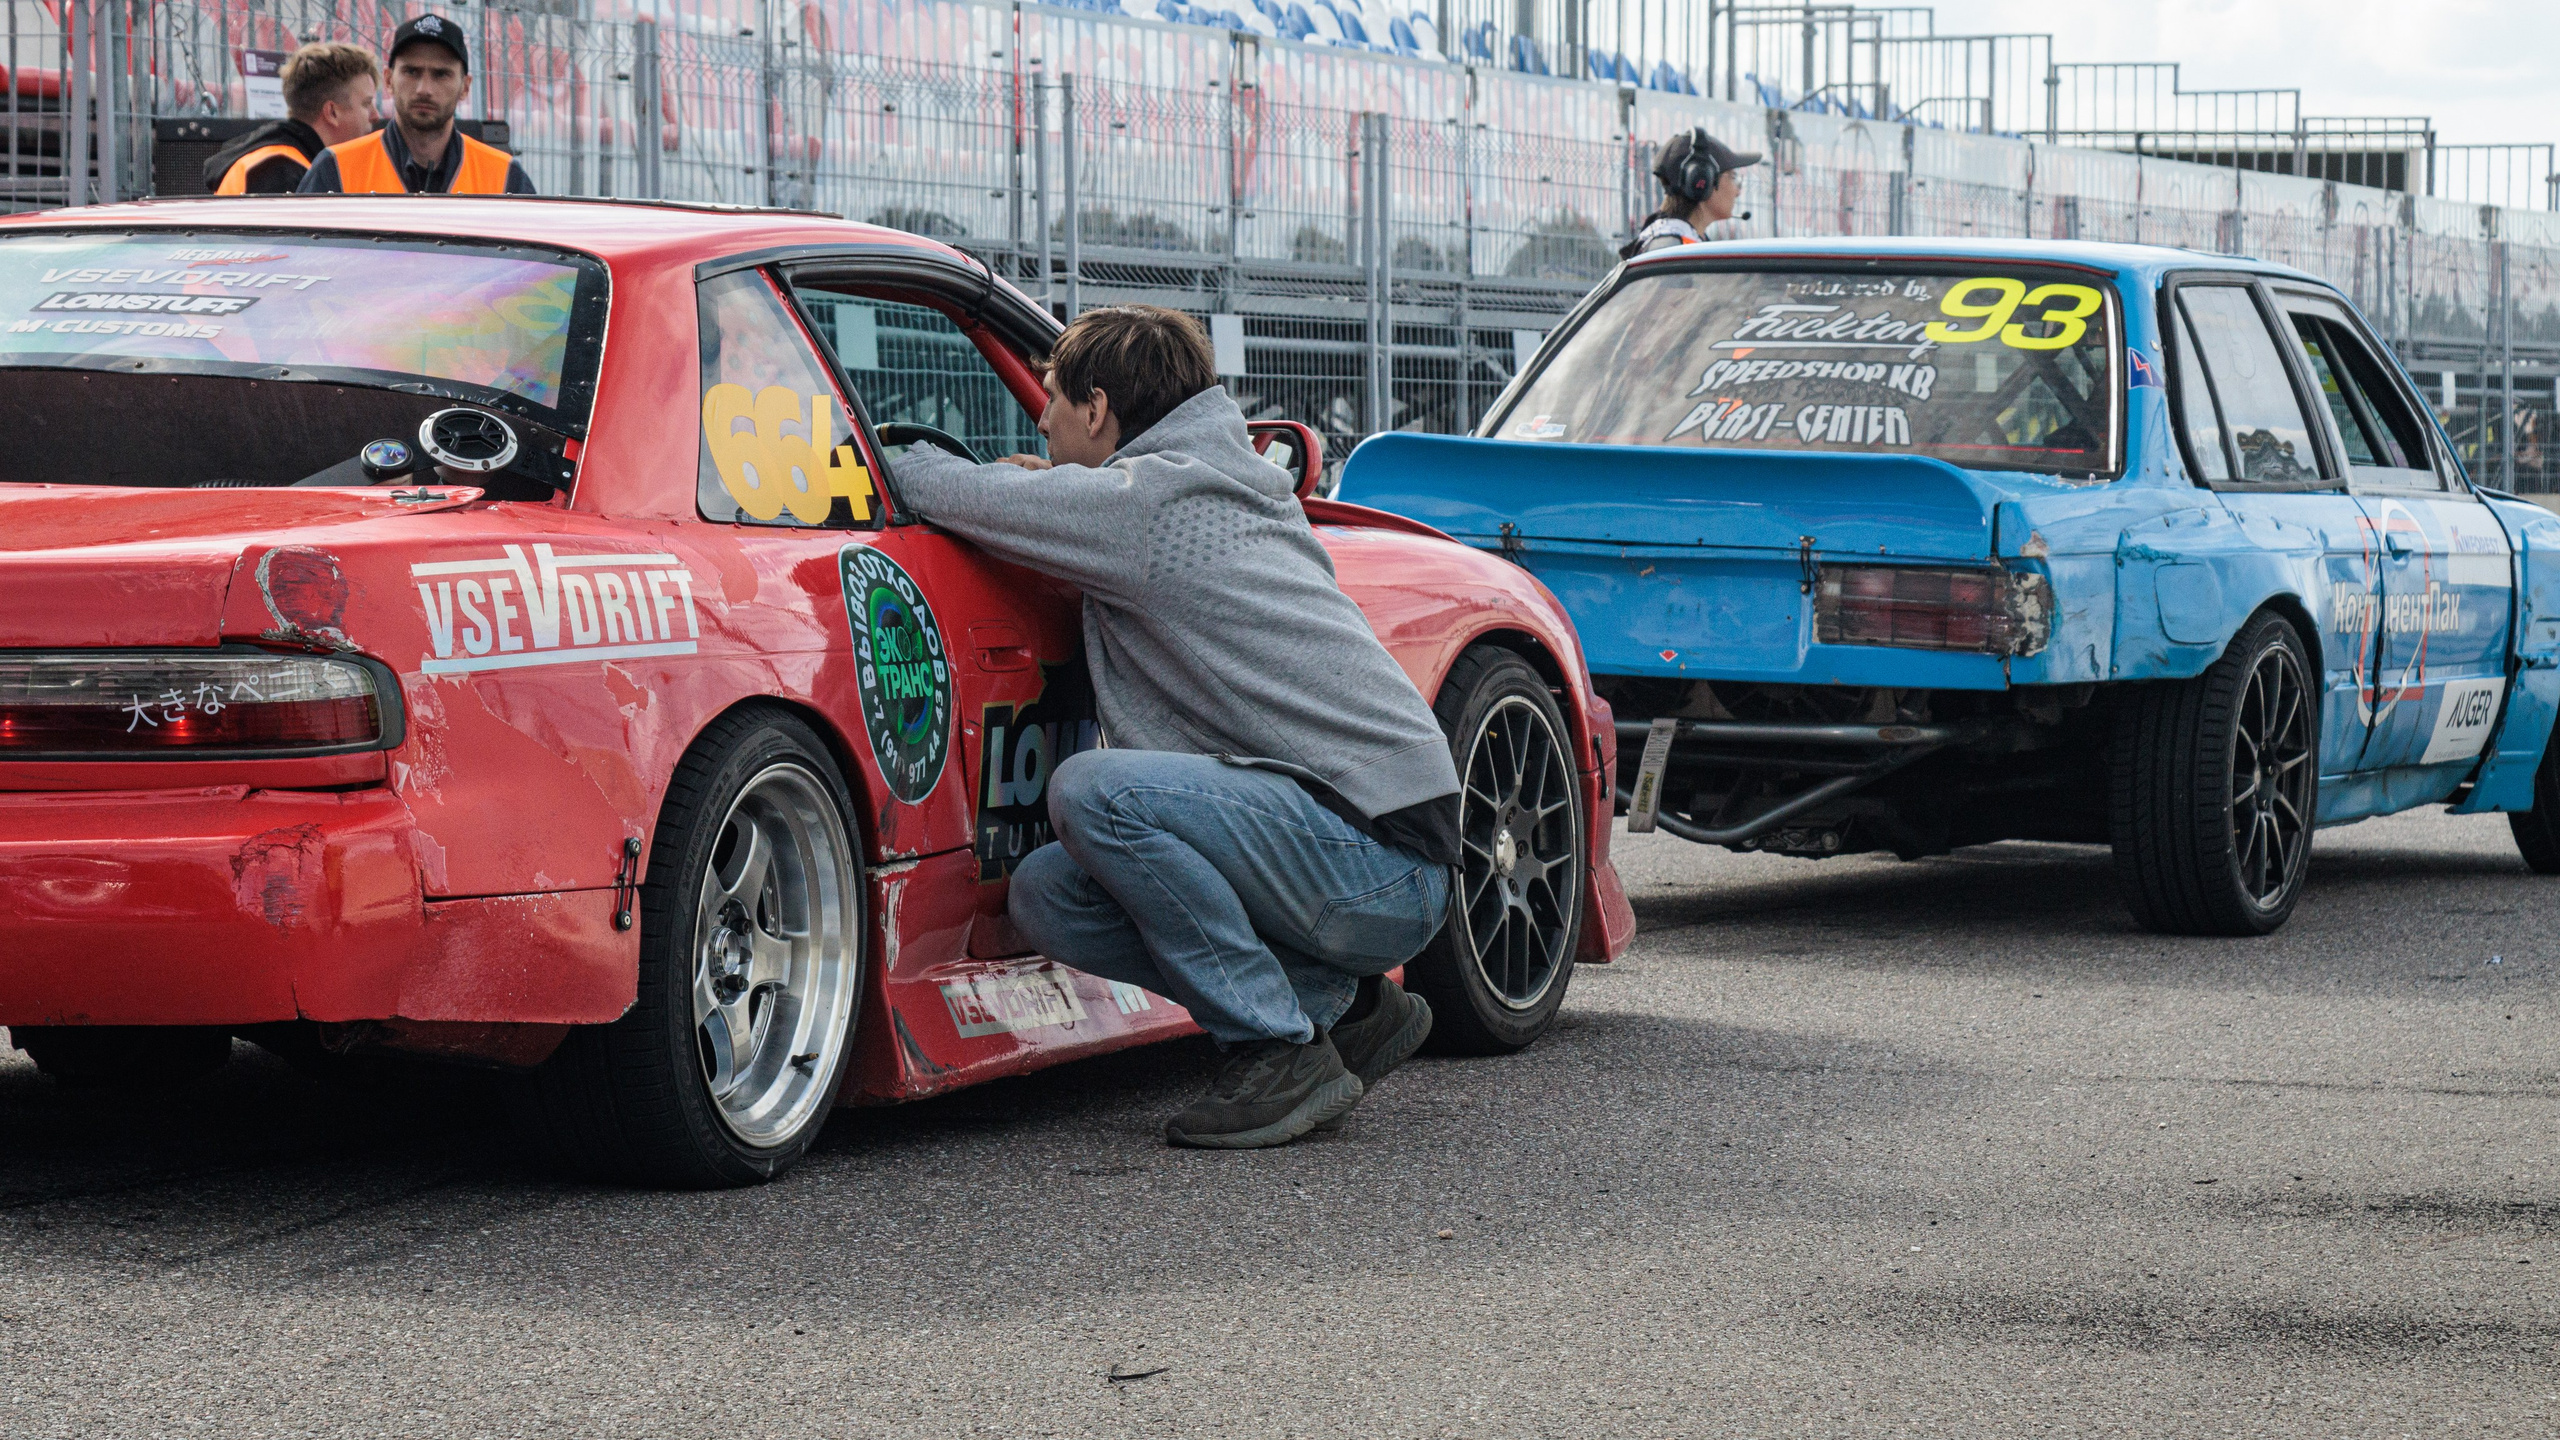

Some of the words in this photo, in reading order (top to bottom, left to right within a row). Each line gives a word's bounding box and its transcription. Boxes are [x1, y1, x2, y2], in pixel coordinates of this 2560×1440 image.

[40, 268, 332, 291] VSEVDRIFT
[40, 293, 250, 314] LOWSTUFF
[1786, 279, 1897, 298] powered
[1903, 280, 1933, 302] by
[1924, 276, 2102, 350] 93
[1664, 401, 1912, 447] BLAST-CENTER
[702, 382, 874, 525] 664
[417, 543, 700, 658] VSEVDRIFT
[848, 562, 876, 690] ВЫВОЗ
[860, 552, 946, 683] ОТХОДОВ
[2333, 580, 2461, 634] КонтинентПак
[879, 661, 934, 701] ТРАНС
[2445, 689, 2493, 729] AUGER
[880, 729, 906, 775] (91)
[908, 755, 926, 784] 977
[928, 729, 941, 763] 44
[935, 689, 944, 725] 43
